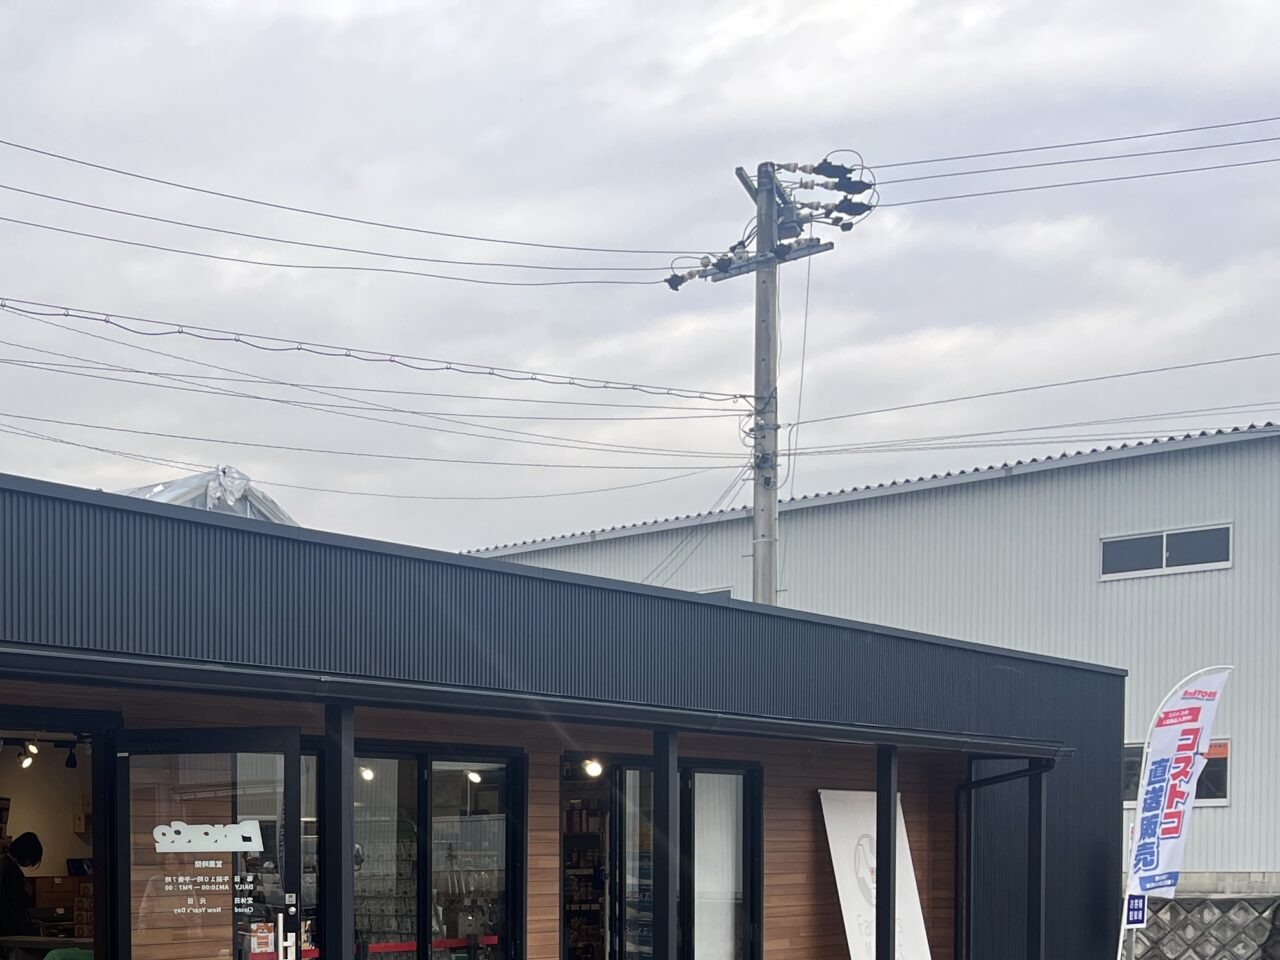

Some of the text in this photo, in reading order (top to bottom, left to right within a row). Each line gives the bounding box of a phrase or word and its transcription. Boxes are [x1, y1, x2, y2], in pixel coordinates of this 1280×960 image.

[1133, 757, 1170, 873] 直送販売
[1160, 727, 1202, 838] コストコ
